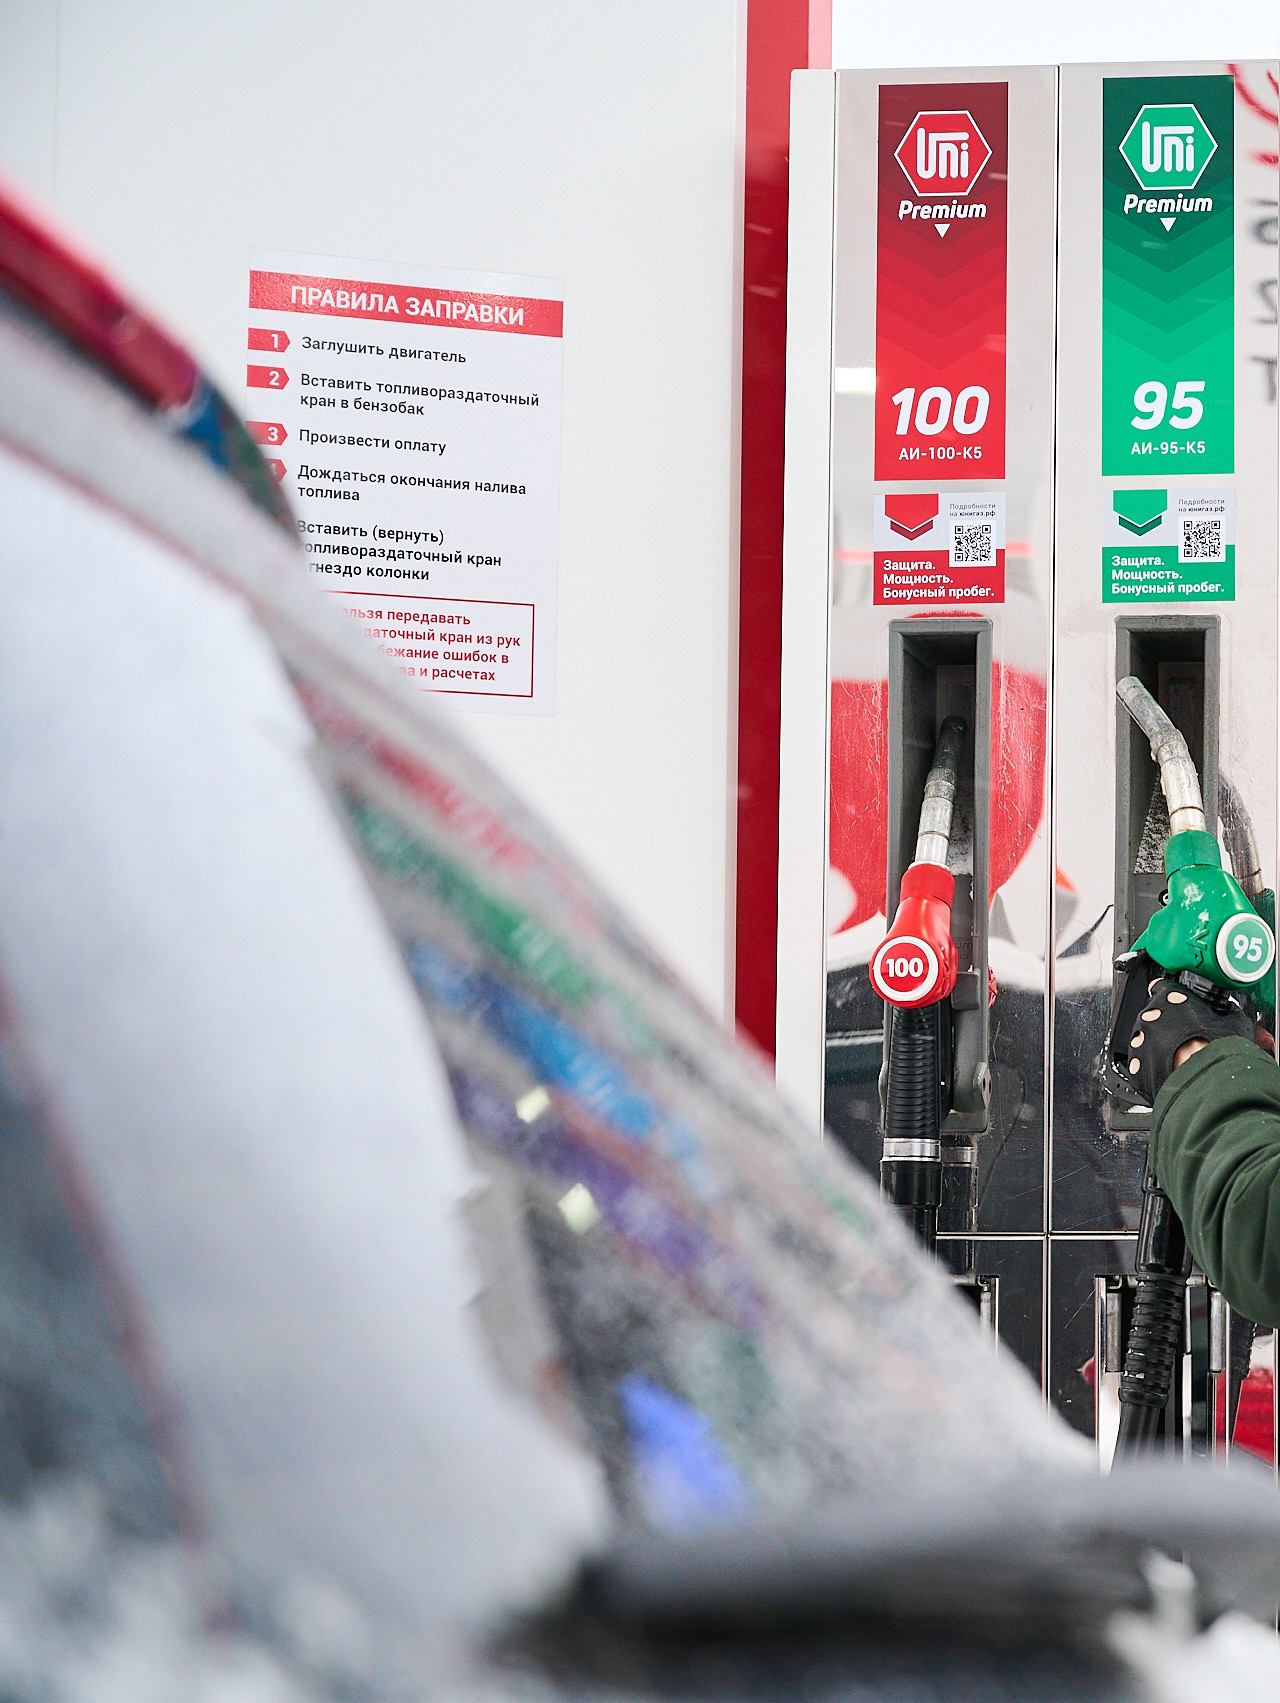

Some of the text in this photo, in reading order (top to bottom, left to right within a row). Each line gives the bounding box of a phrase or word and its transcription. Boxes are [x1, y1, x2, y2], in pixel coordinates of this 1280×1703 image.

[898, 199, 987, 220] Premium
[1123, 193, 1213, 214] Premium
[291, 286, 525, 326] ПРАВИЛА ЗАПРАВКИ
[270, 333, 280, 350] 1
[301, 336, 467, 364] Заглушить двигатель
[268, 370, 280, 386] 2
[300, 373, 540, 407] Вставить топливораздаточный
[300, 395, 425, 416] кран в бензобак
[891, 385, 990, 436] 100
[1130, 380, 1206, 431] 95
[267, 426, 279, 442] 3
[299, 429, 447, 457] Произвести оплату
[899, 446, 983, 461] АИ-100-К5
[1130, 441, 1206, 456] АИ-95-К5
[297, 464, 527, 496] Дождаться окончания налива
[297, 486, 361, 501] топлива
[297, 519, 445, 546] Вставить (вернуть)
[301, 541, 502, 569] опливораздаточный кран
[1111, 554, 1165, 569] Защита.
[309, 562, 430, 582] гнездо колонки
[883, 559, 936, 573] Защита.
[1111, 568, 1183, 582] Мощность.
[883, 573, 954, 587] Мощность.
[1111, 580, 1225, 596] Бонусный пробег.
[883, 585, 995, 600] Бонусный пробег.
[337, 604, 471, 626] ельзя передавать
[440, 632, 473, 646] кран
[476, 634, 493, 645] из
[496, 635, 522, 650] рук
[378, 643, 510, 664] бежание ошибок в
[432, 665, 496, 682] расчетах
[1230, 934, 1264, 961] 95
[884, 956, 925, 979] 100
